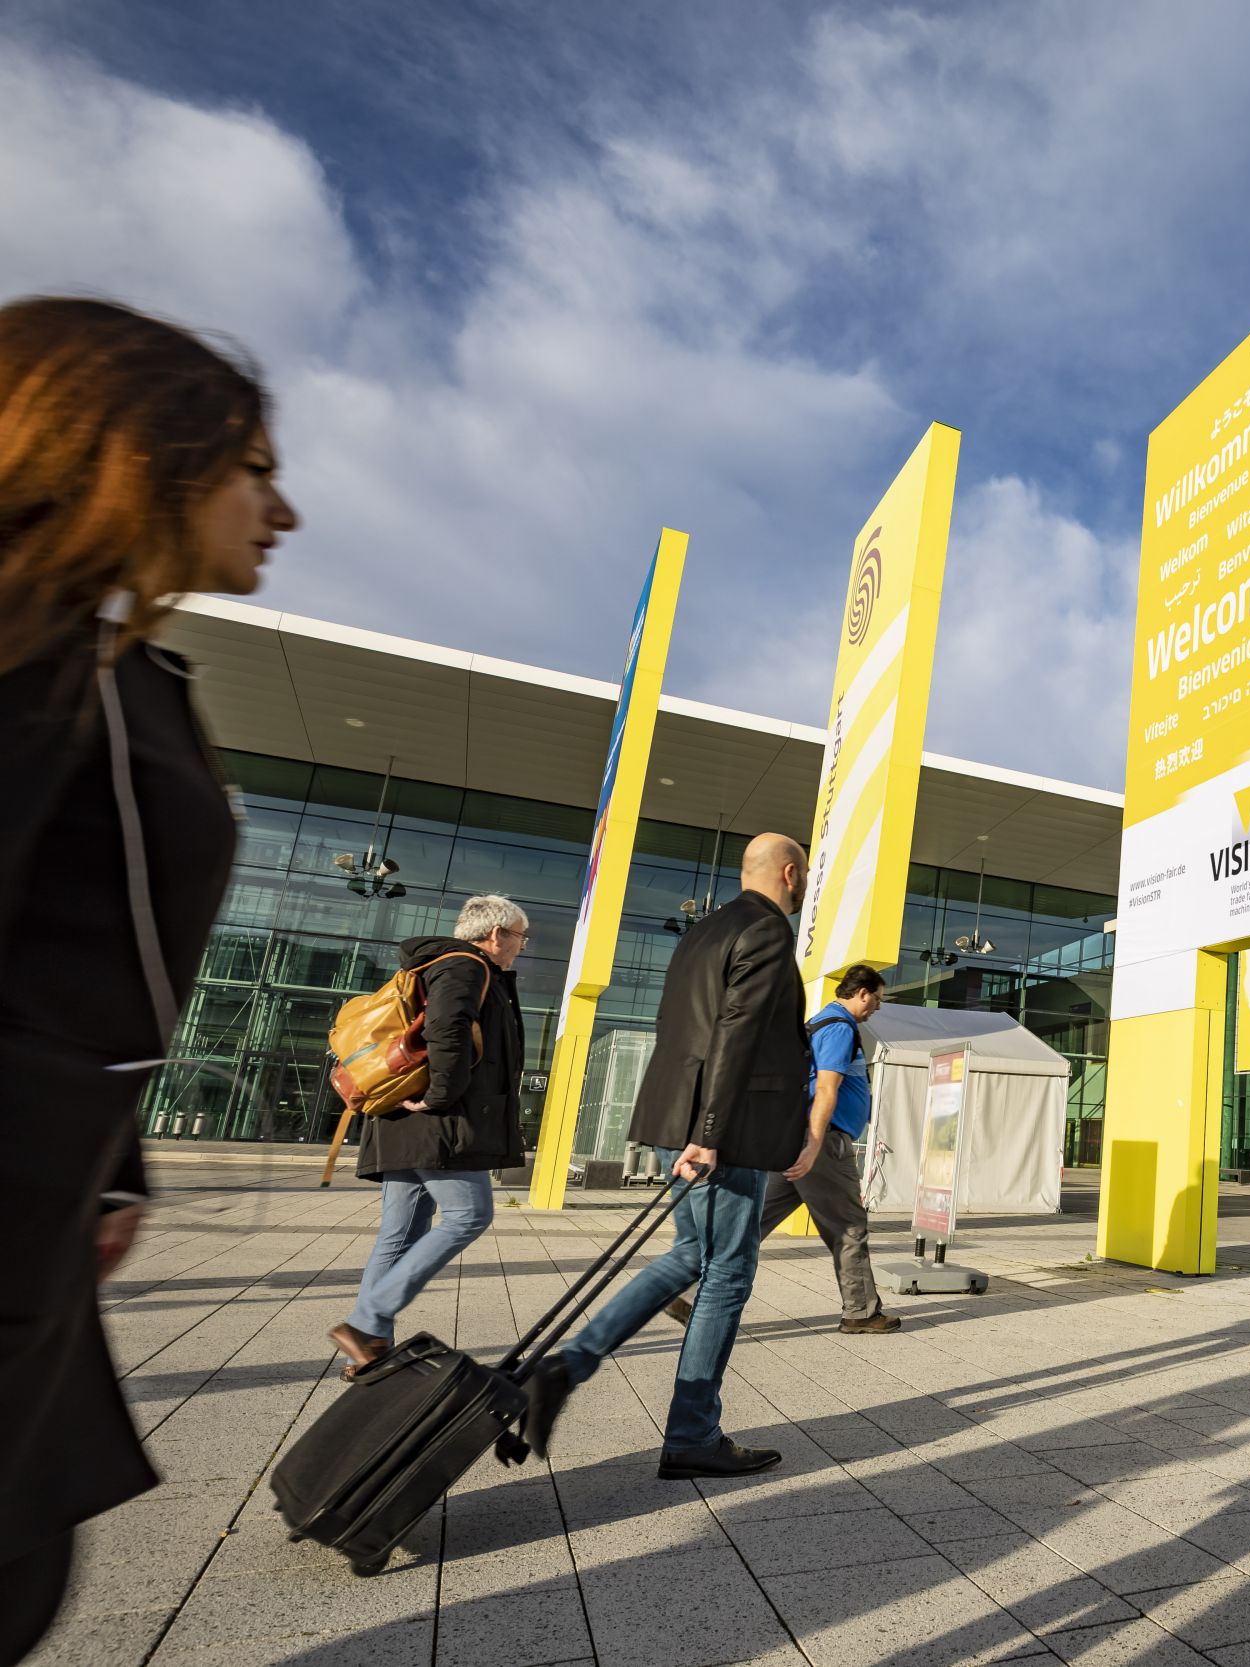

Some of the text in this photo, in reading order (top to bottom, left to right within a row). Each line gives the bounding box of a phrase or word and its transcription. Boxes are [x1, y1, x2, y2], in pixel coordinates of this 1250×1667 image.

[1188, 470, 1249, 529] Bienvenue
[1159, 533, 1209, 583] Welkom
[804, 691, 845, 958] Messe Stuttgart
[1129, 863, 1186, 892] www.vision-fair.de
[1128, 889, 1162, 909] #VisionSTR
[1230, 891, 1245, 906] trade
